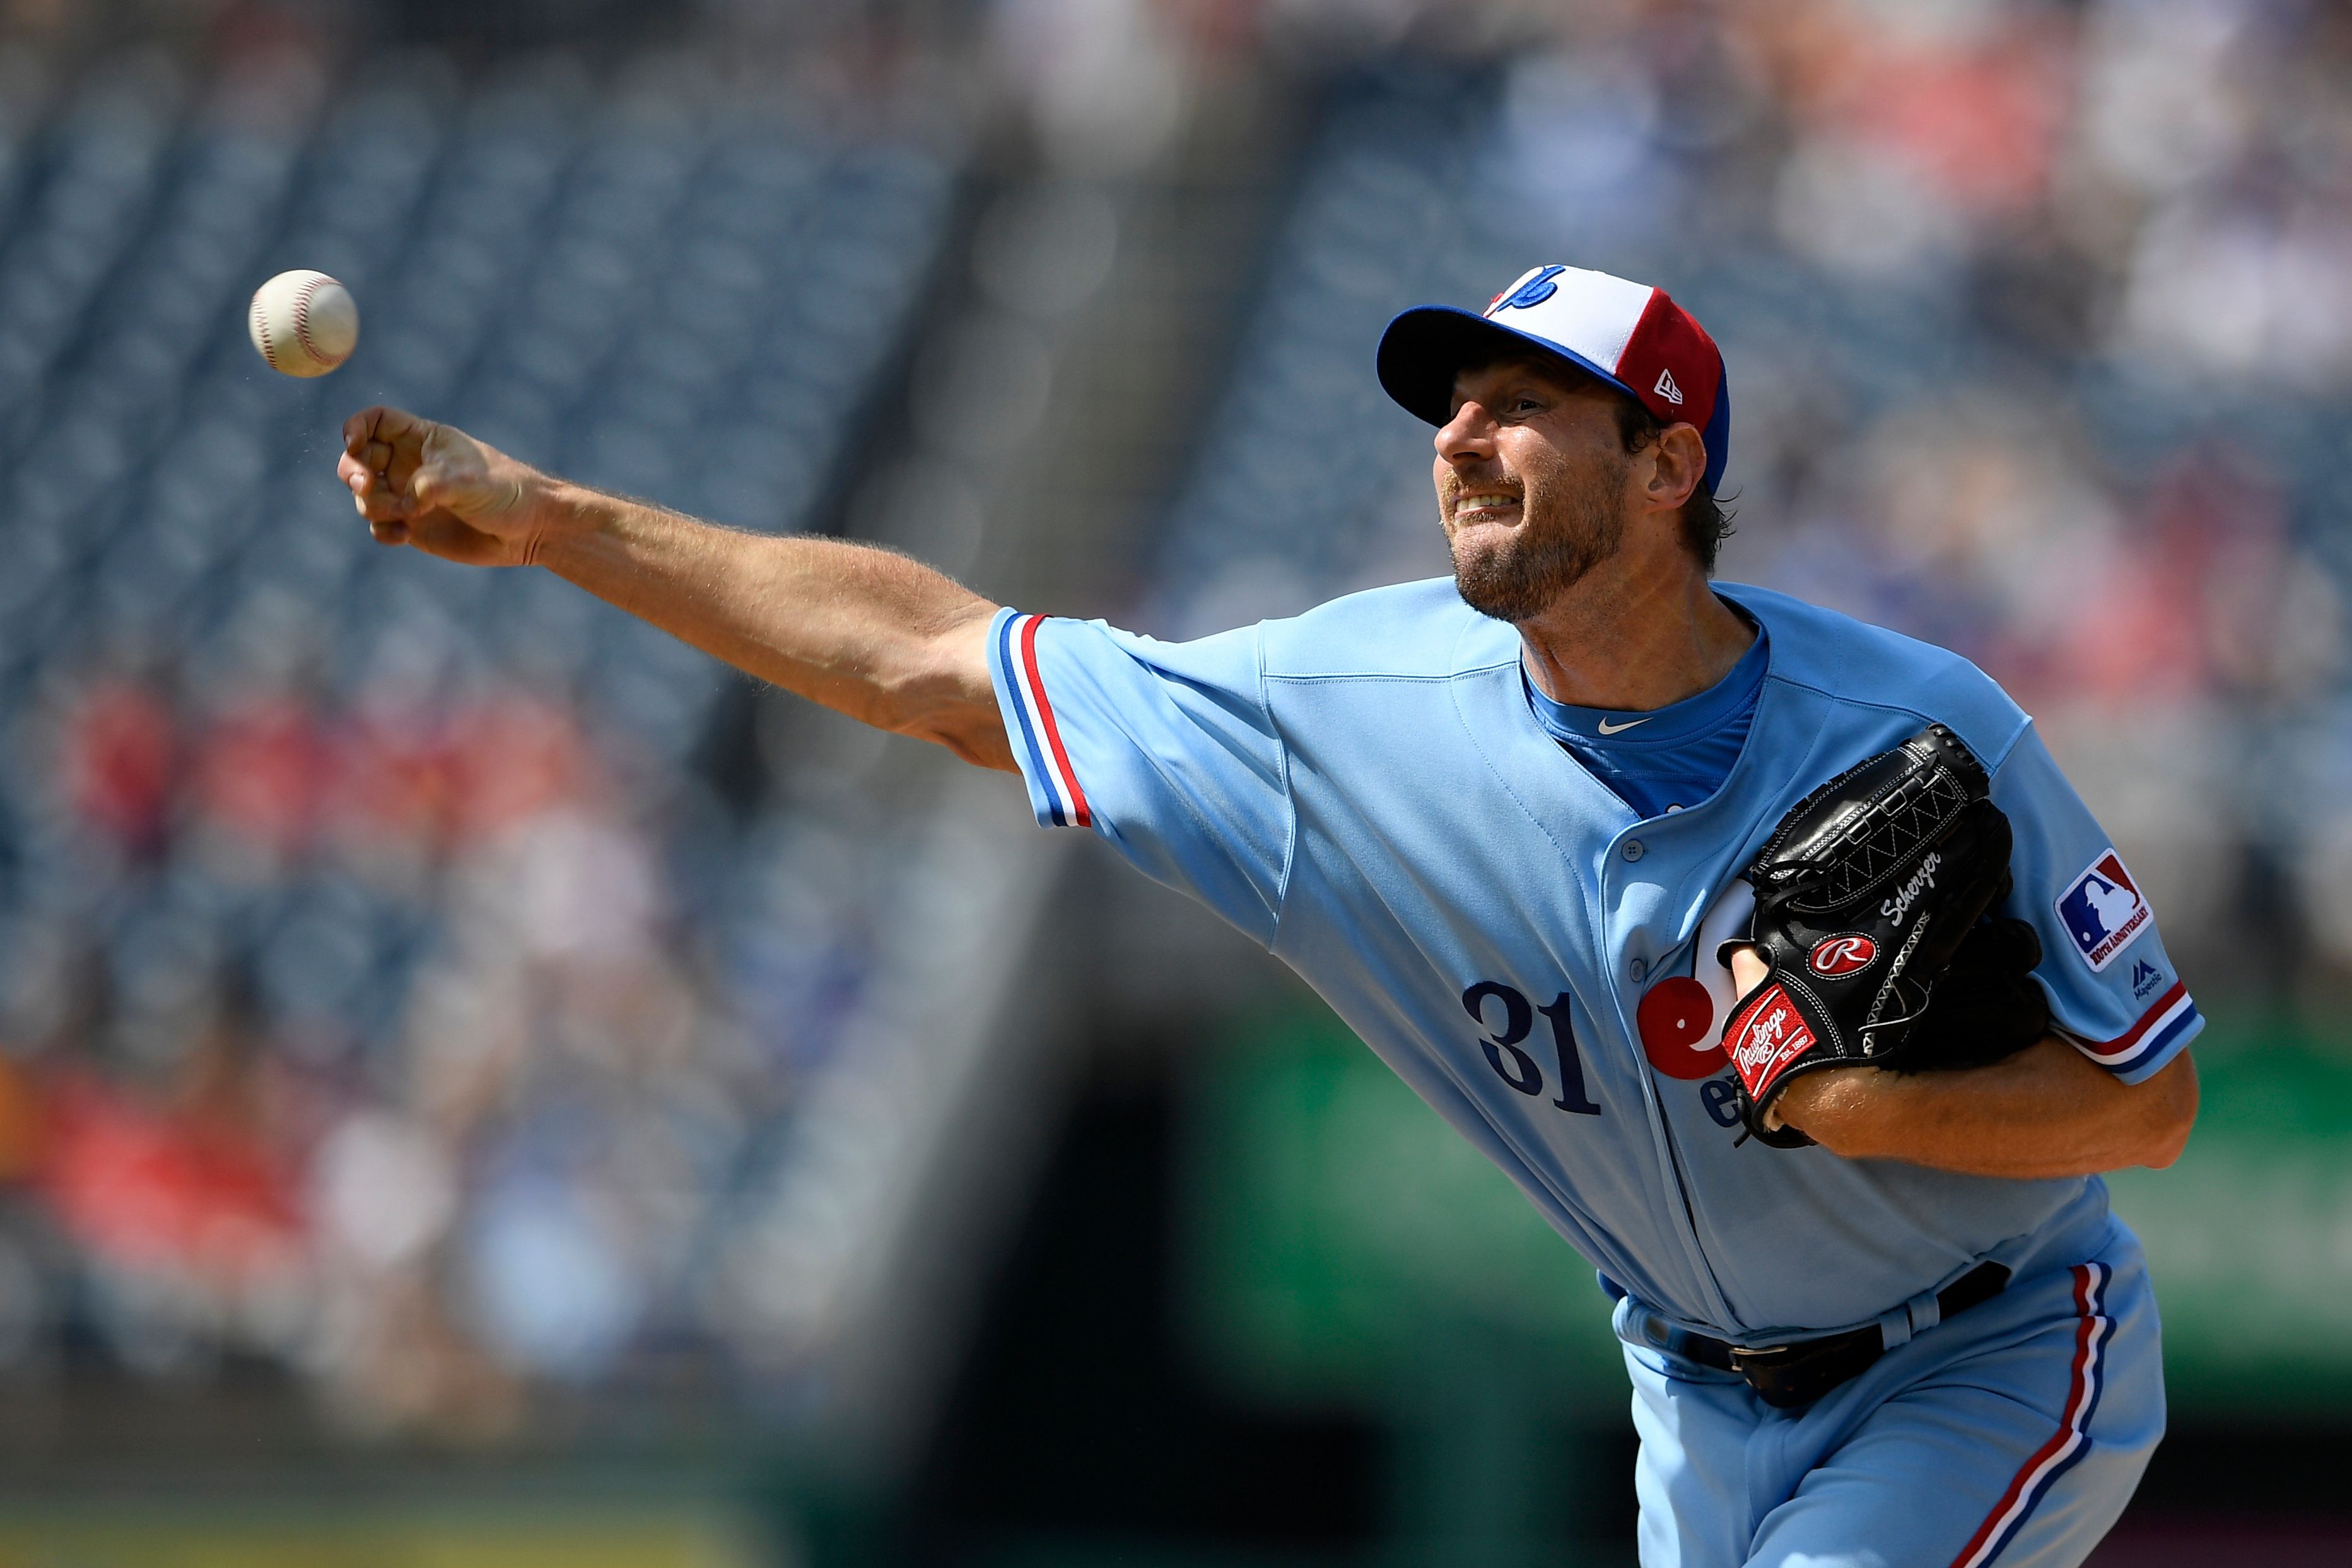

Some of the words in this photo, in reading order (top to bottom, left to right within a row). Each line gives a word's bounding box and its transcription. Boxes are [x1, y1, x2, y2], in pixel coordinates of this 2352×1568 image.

[1880, 851, 1941, 927] Scherzer
[1816, 937, 1868, 971] R
[2134, 973, 2163, 1001] Majestic
[1462, 980, 1602, 1116] 31
[1739, 1008, 1786, 1075] Rawlings
[1791, 1034, 1808, 1051] 1887
